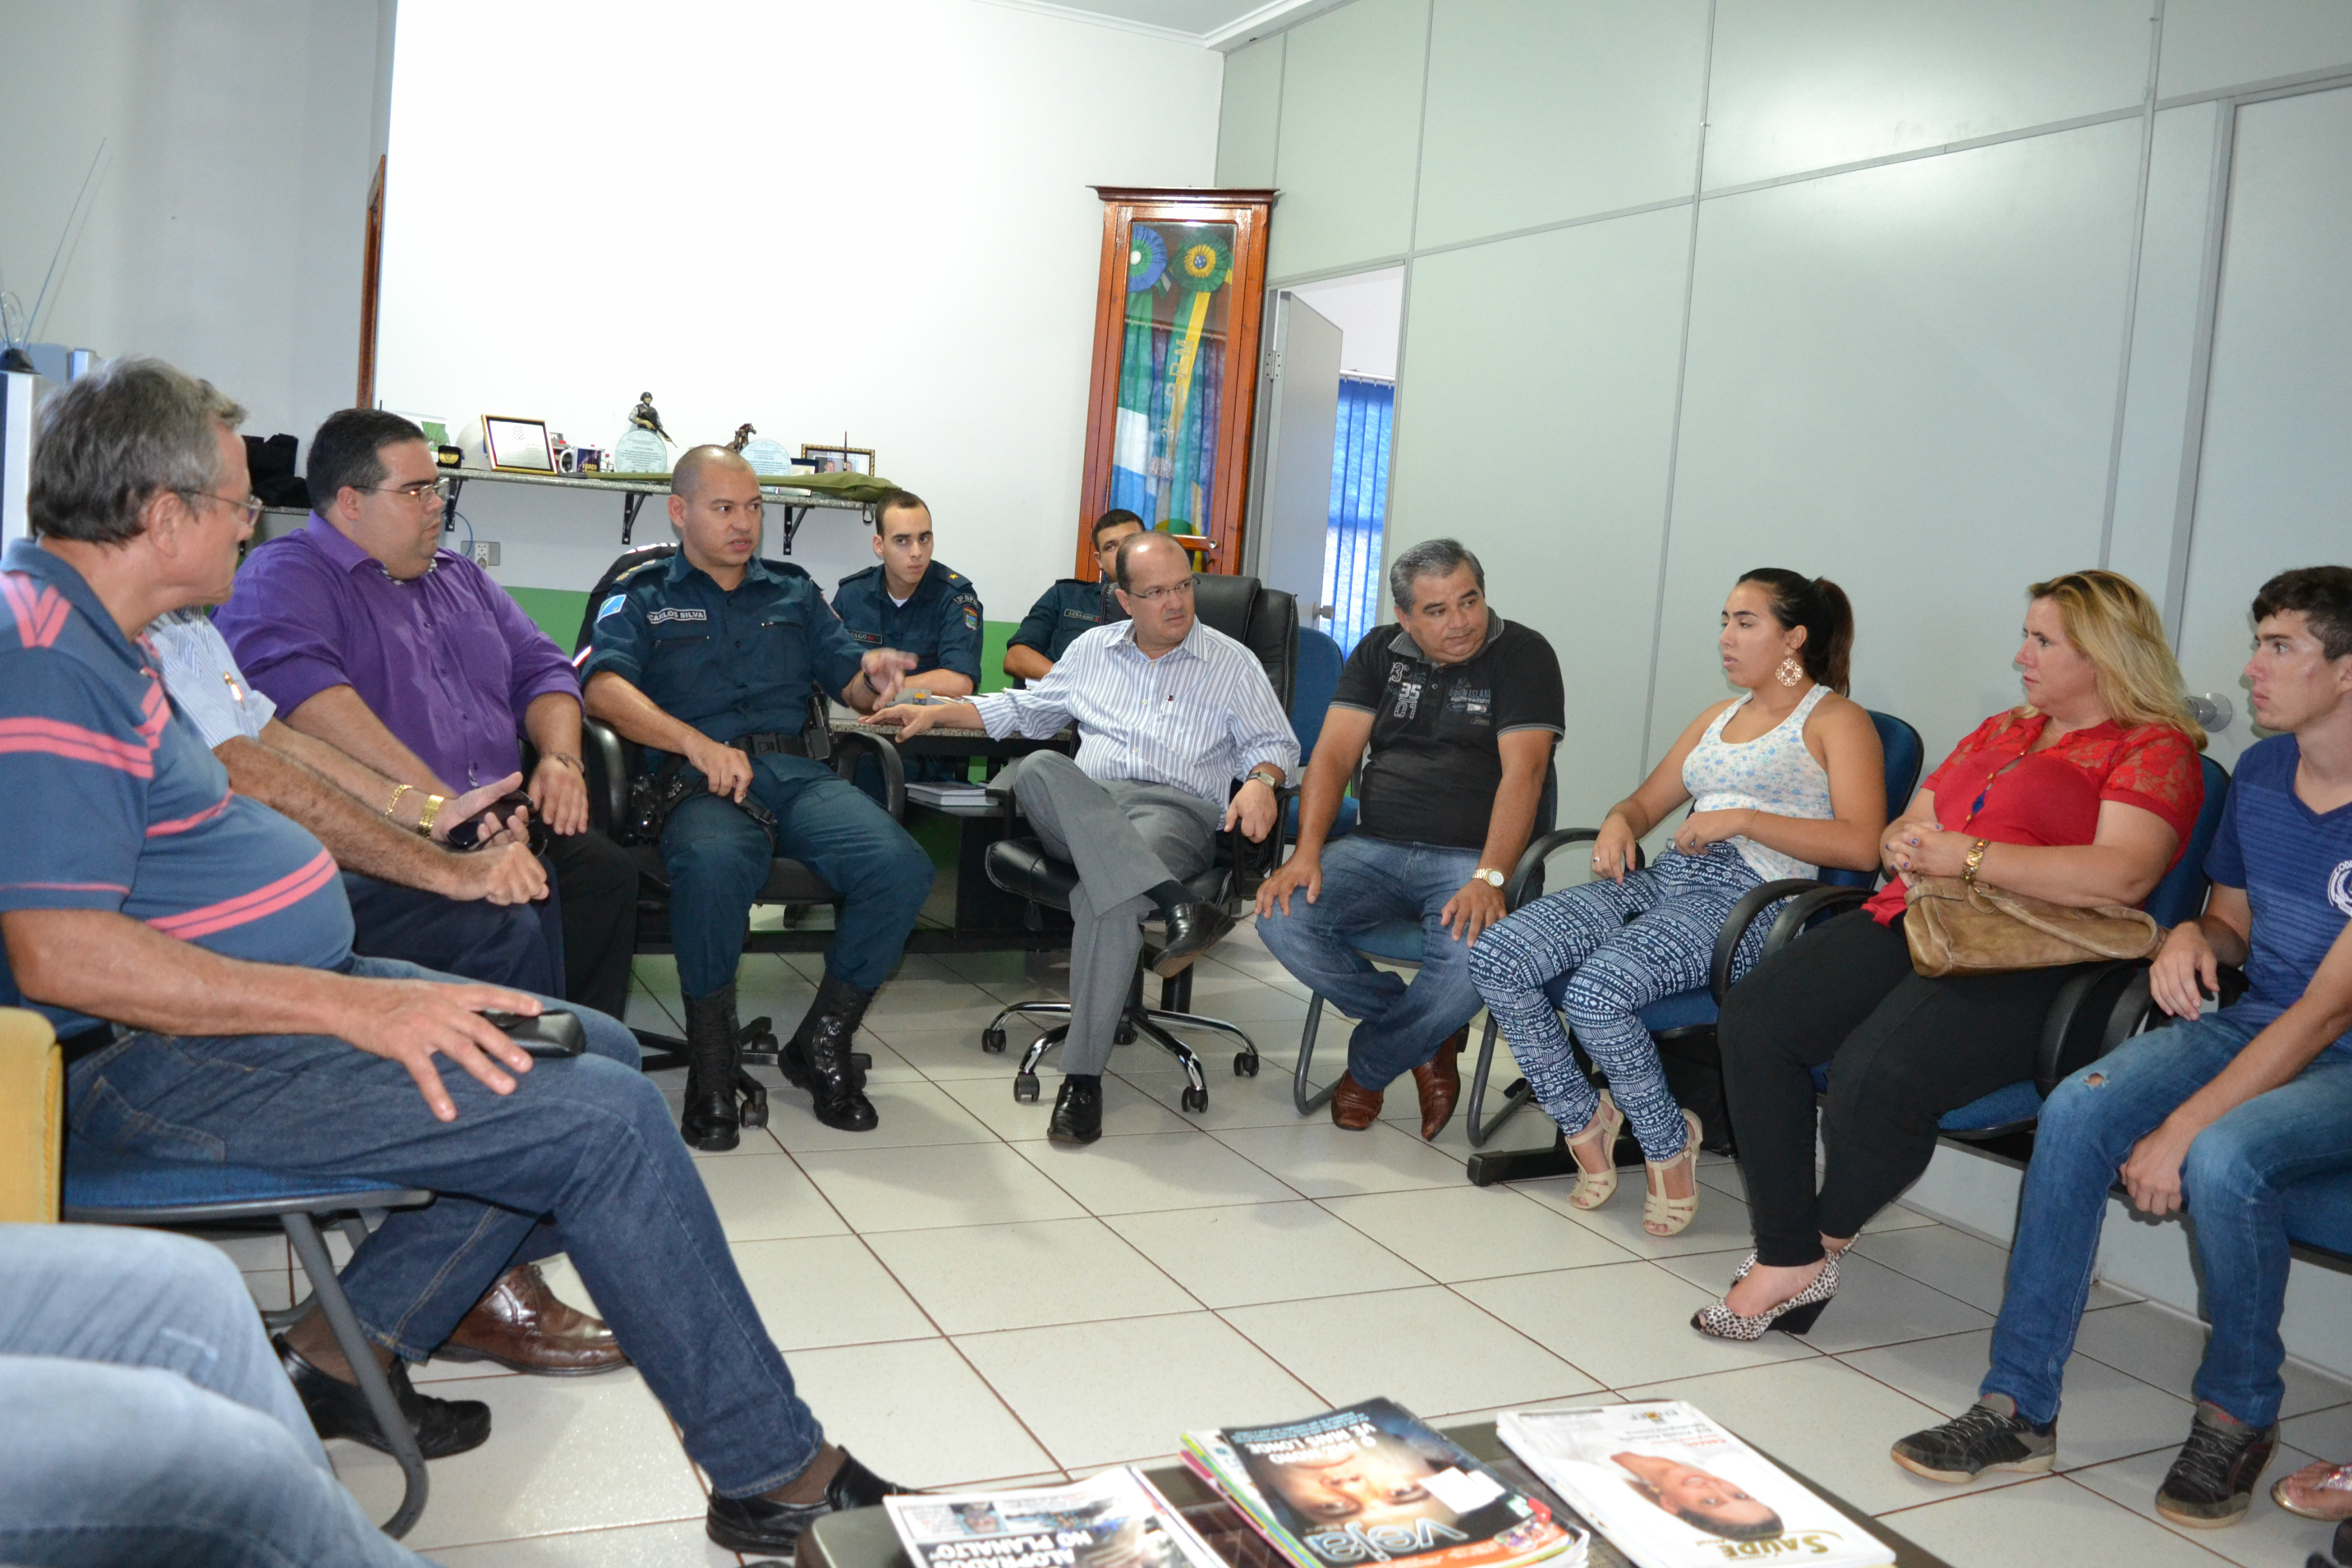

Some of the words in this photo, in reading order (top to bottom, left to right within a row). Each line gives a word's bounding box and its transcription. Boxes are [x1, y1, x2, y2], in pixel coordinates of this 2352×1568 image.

[649, 610, 678, 621] CARLOS
[1399, 682, 1422, 700] 35
[1057, 1530, 1093, 1548] NO
[1303, 1517, 1469, 1562] veja
[1718, 1535, 1829, 1558] SAÚDE
